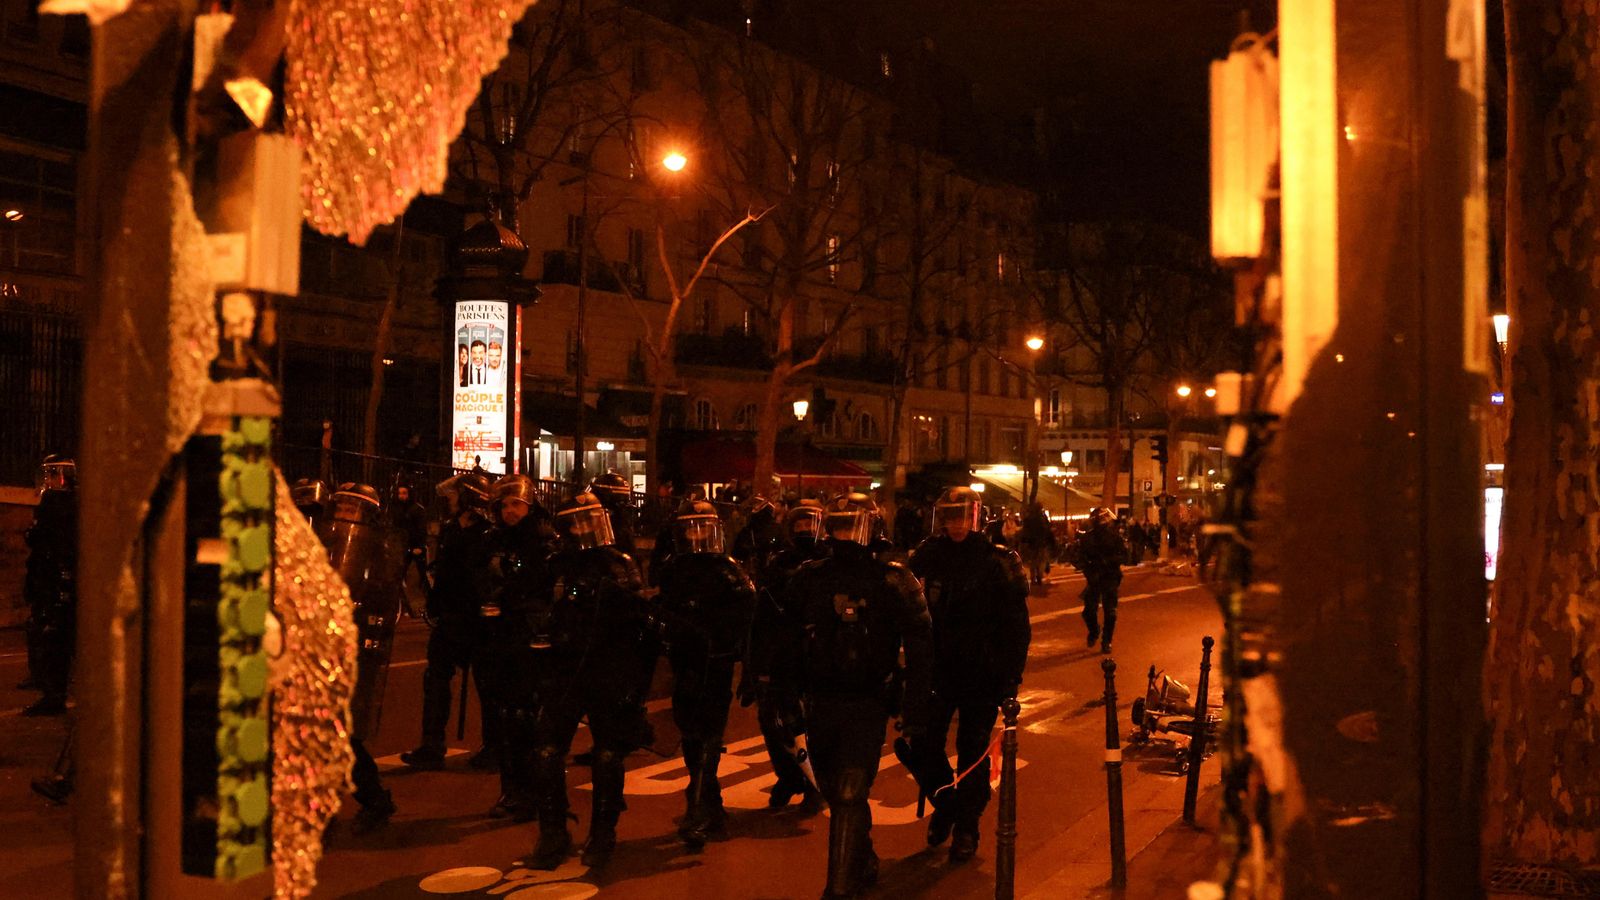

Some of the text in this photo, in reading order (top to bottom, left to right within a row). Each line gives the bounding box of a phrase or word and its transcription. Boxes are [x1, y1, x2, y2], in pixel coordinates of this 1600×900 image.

[459, 304, 503, 312] BOUFFES
[457, 312, 505, 320] PARISIENS
[455, 393, 504, 404] COUPLE
